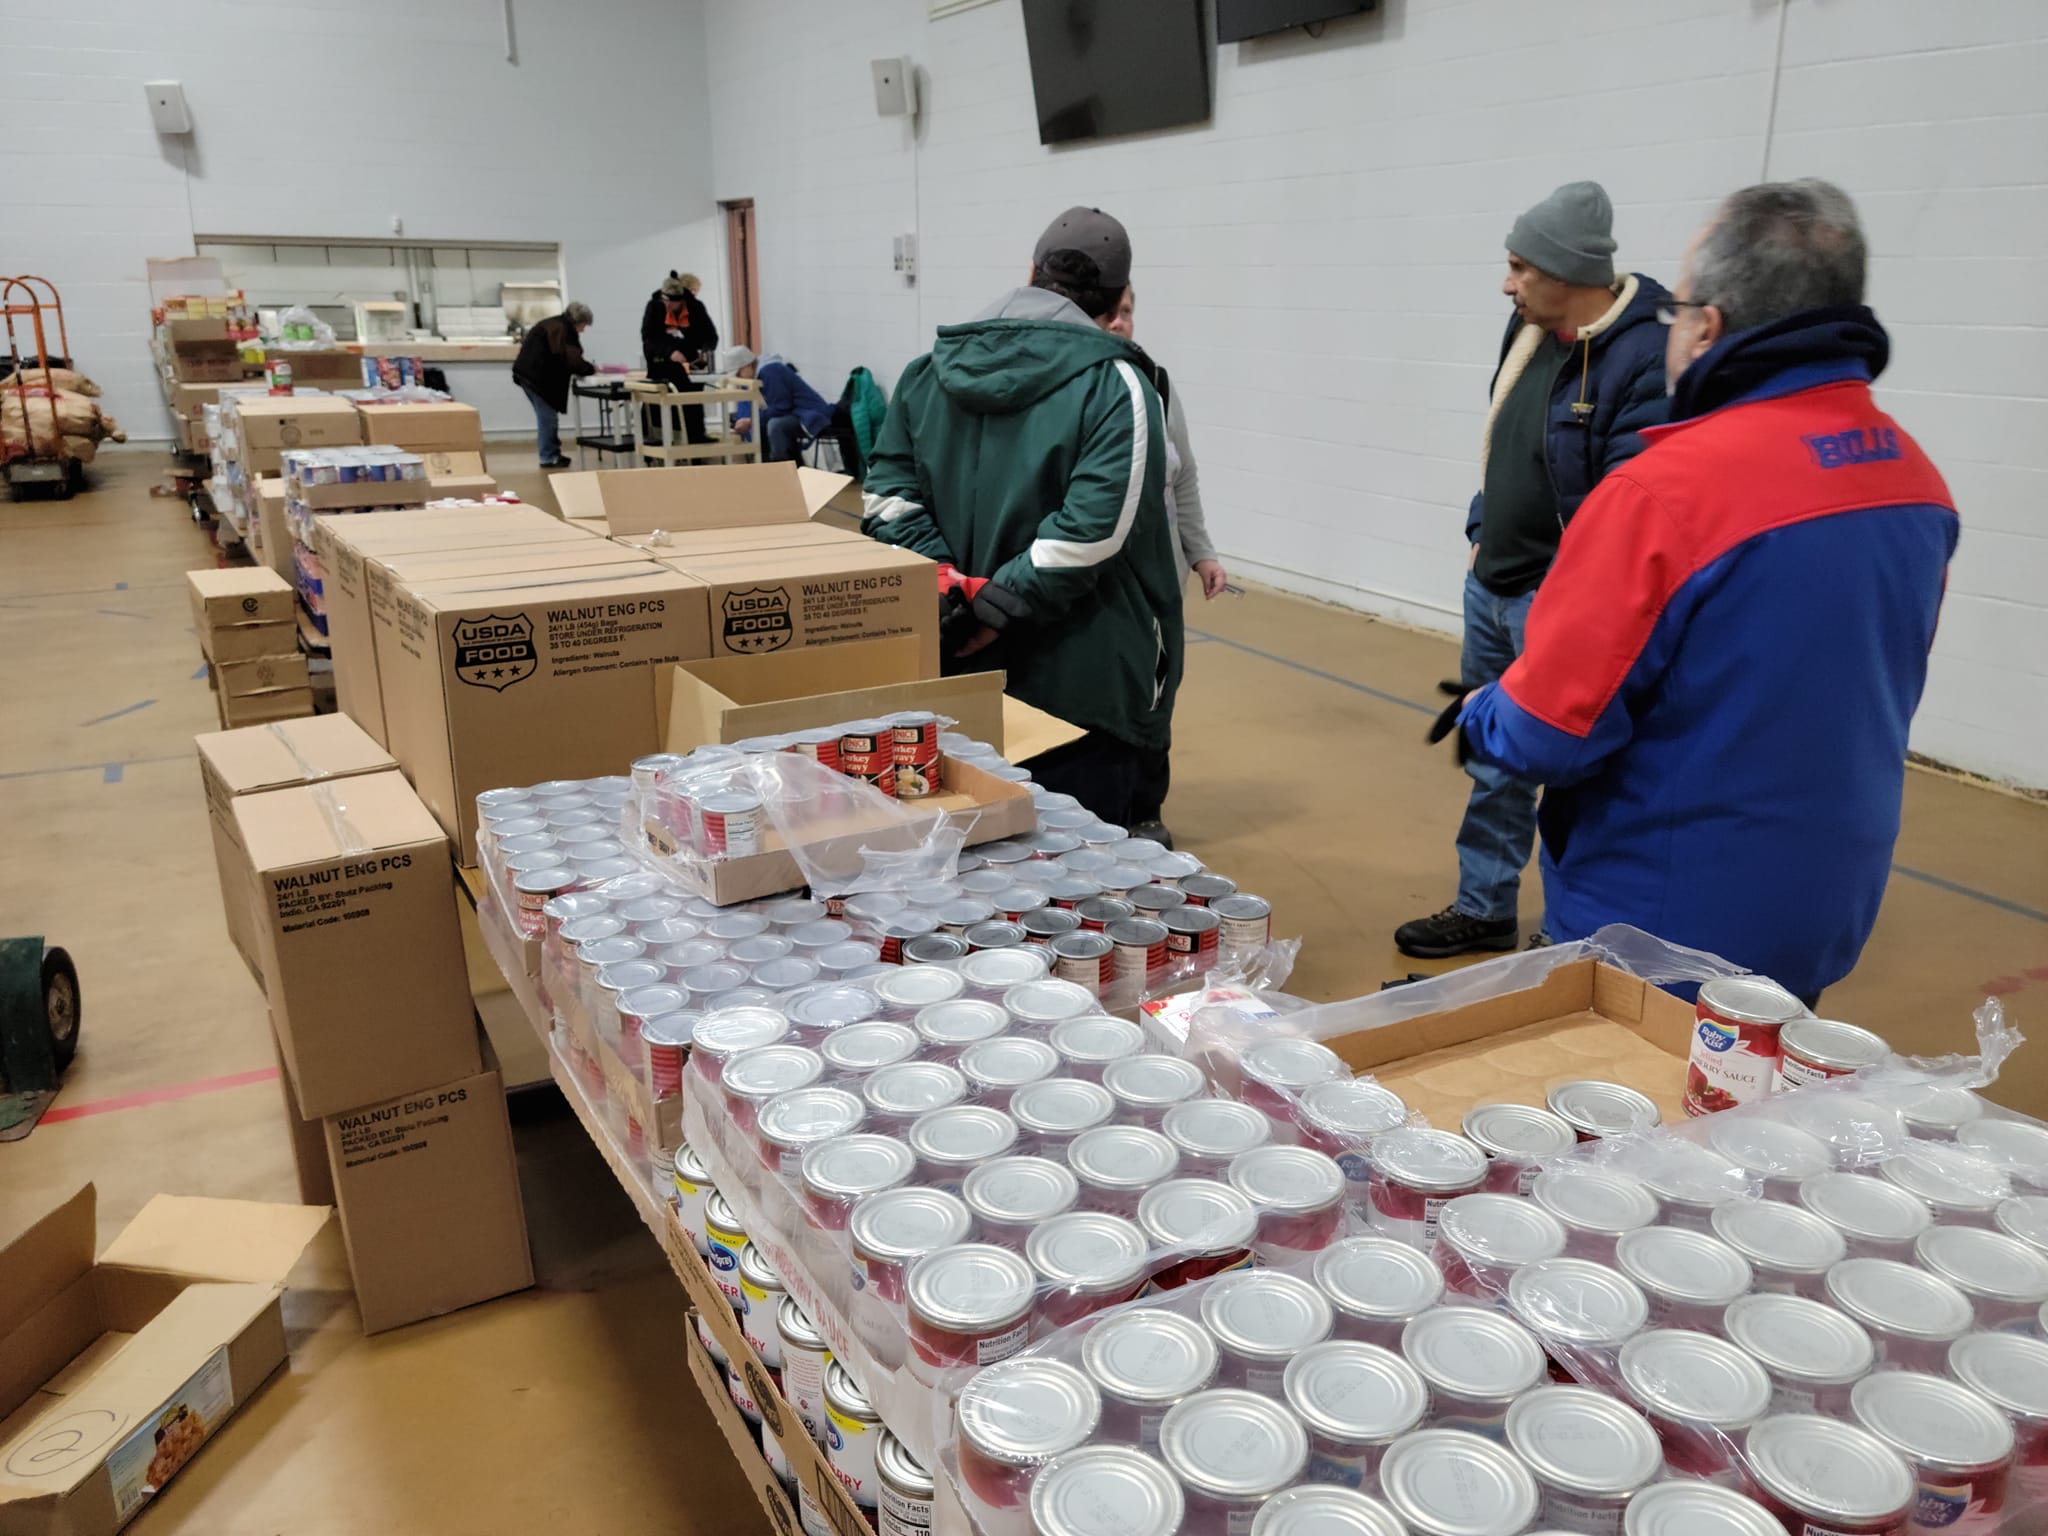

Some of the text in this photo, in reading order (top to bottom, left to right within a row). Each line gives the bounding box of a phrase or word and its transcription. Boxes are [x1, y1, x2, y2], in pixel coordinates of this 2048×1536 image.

[802, 575, 903, 596] WALNUT ENG PCS
[547, 599, 665, 623] WALNUT ENG PCS
[730, 596, 783, 612] USDA
[803, 604, 825, 612] STORE
[462, 623, 526, 640] USDA
[549, 622, 663, 641] STORE UNDER REFRIGERATION
[565, 623, 575, 631] LB
[732, 616, 785, 632] FOOD
[561, 640, 571, 648] TO
[583, 636, 618, 646] DEGREES
[465, 645, 528, 663] FOOD
[274, 855, 412, 891] WALNUT ENG PCS
[278, 896, 316, 909] PACKED
[359, 882, 393, 894] Packing
[297, 888, 309, 898] LB
[306, 904, 320, 913] CA
[282, 920, 315, 933] Material
[1702, 1026, 1726, 1042] Ruby
[1704, 1036, 1724, 1049] Kist
[1722, 1069, 1756, 1084] SAUCE
[1785, 1058, 1825, 1080] Nutrition Facts
[338, 1089, 467, 1131] WALNUT ENG PCS
[1427, 1200, 1448, 1208] Nutri
[979, 1335, 1012, 1349] Nutrition
[30, 1429, 83, 1463] 2
[907, 1503, 929, 1513] Facts
